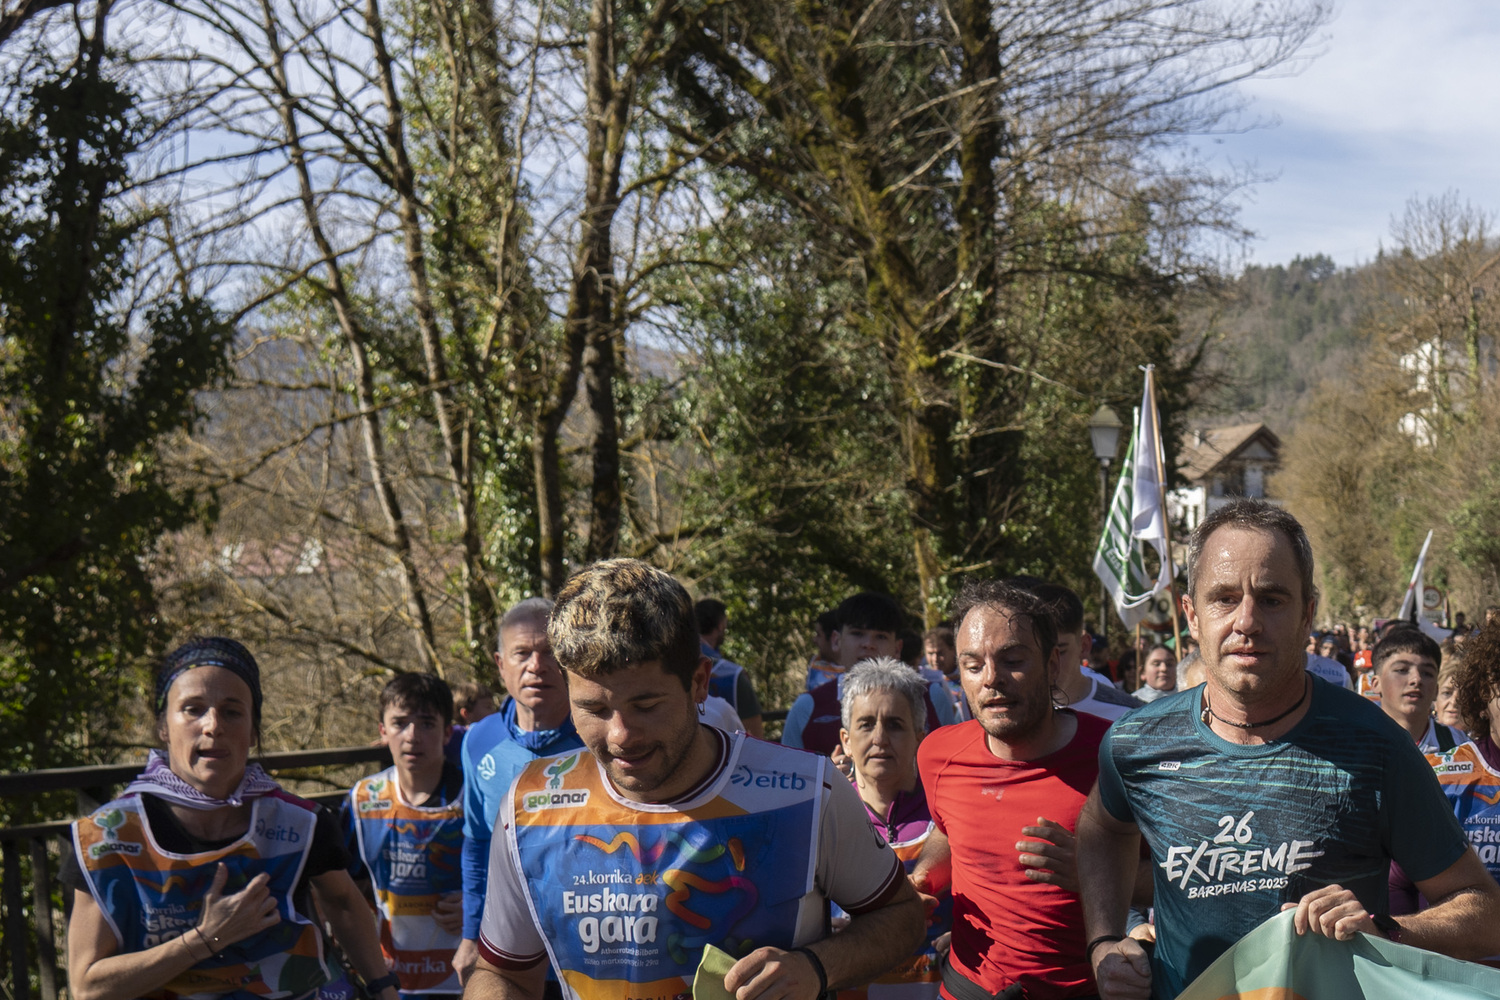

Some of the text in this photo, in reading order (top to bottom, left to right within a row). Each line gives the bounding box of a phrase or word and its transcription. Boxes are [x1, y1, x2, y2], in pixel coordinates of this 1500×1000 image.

[755, 774, 806, 791] eitb
[527, 790, 587, 809] goiener
[265, 826, 300, 843] eitb
[1214, 811, 1254, 844] 26
[1160, 840, 1325, 890] EXTREME
[572, 868, 633, 886] 24.korrika
[1187, 876, 1289, 899] BARDENAS 2025
[562, 886, 659, 914] Euskara
[578, 914, 658, 953] gara
